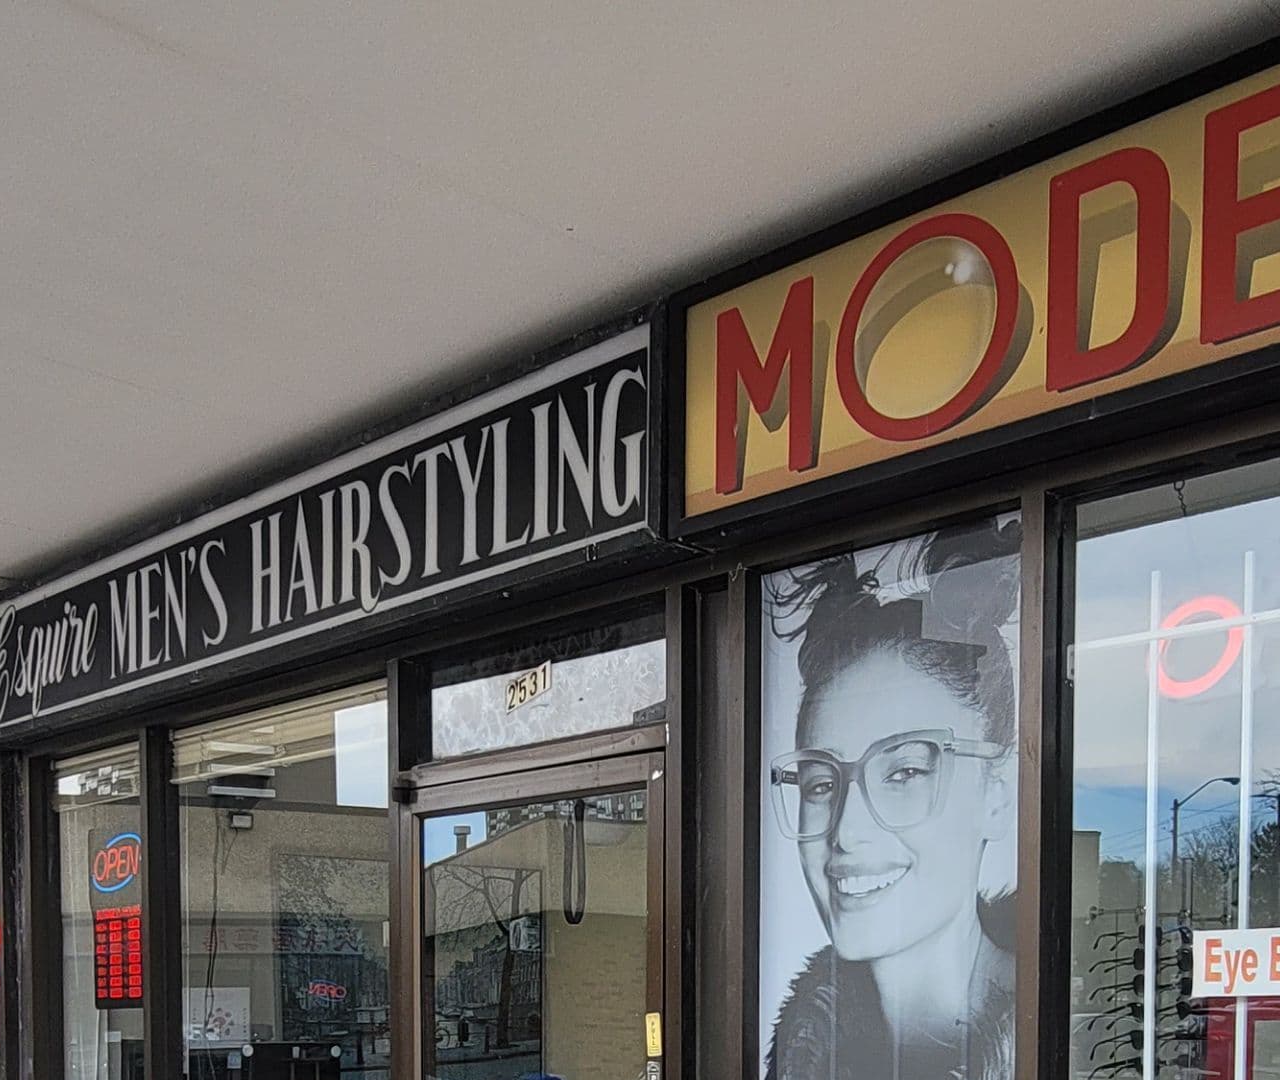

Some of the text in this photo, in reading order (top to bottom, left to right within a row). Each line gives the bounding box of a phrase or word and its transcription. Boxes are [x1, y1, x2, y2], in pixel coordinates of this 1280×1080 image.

[108, 536, 226, 679] MEN'S
[249, 367, 646, 634] HAIRSTYLING
[507, 664, 549, 711] 2531
[94, 845, 140, 881] OPEN
[1204, 939, 1257, 993] Eye
